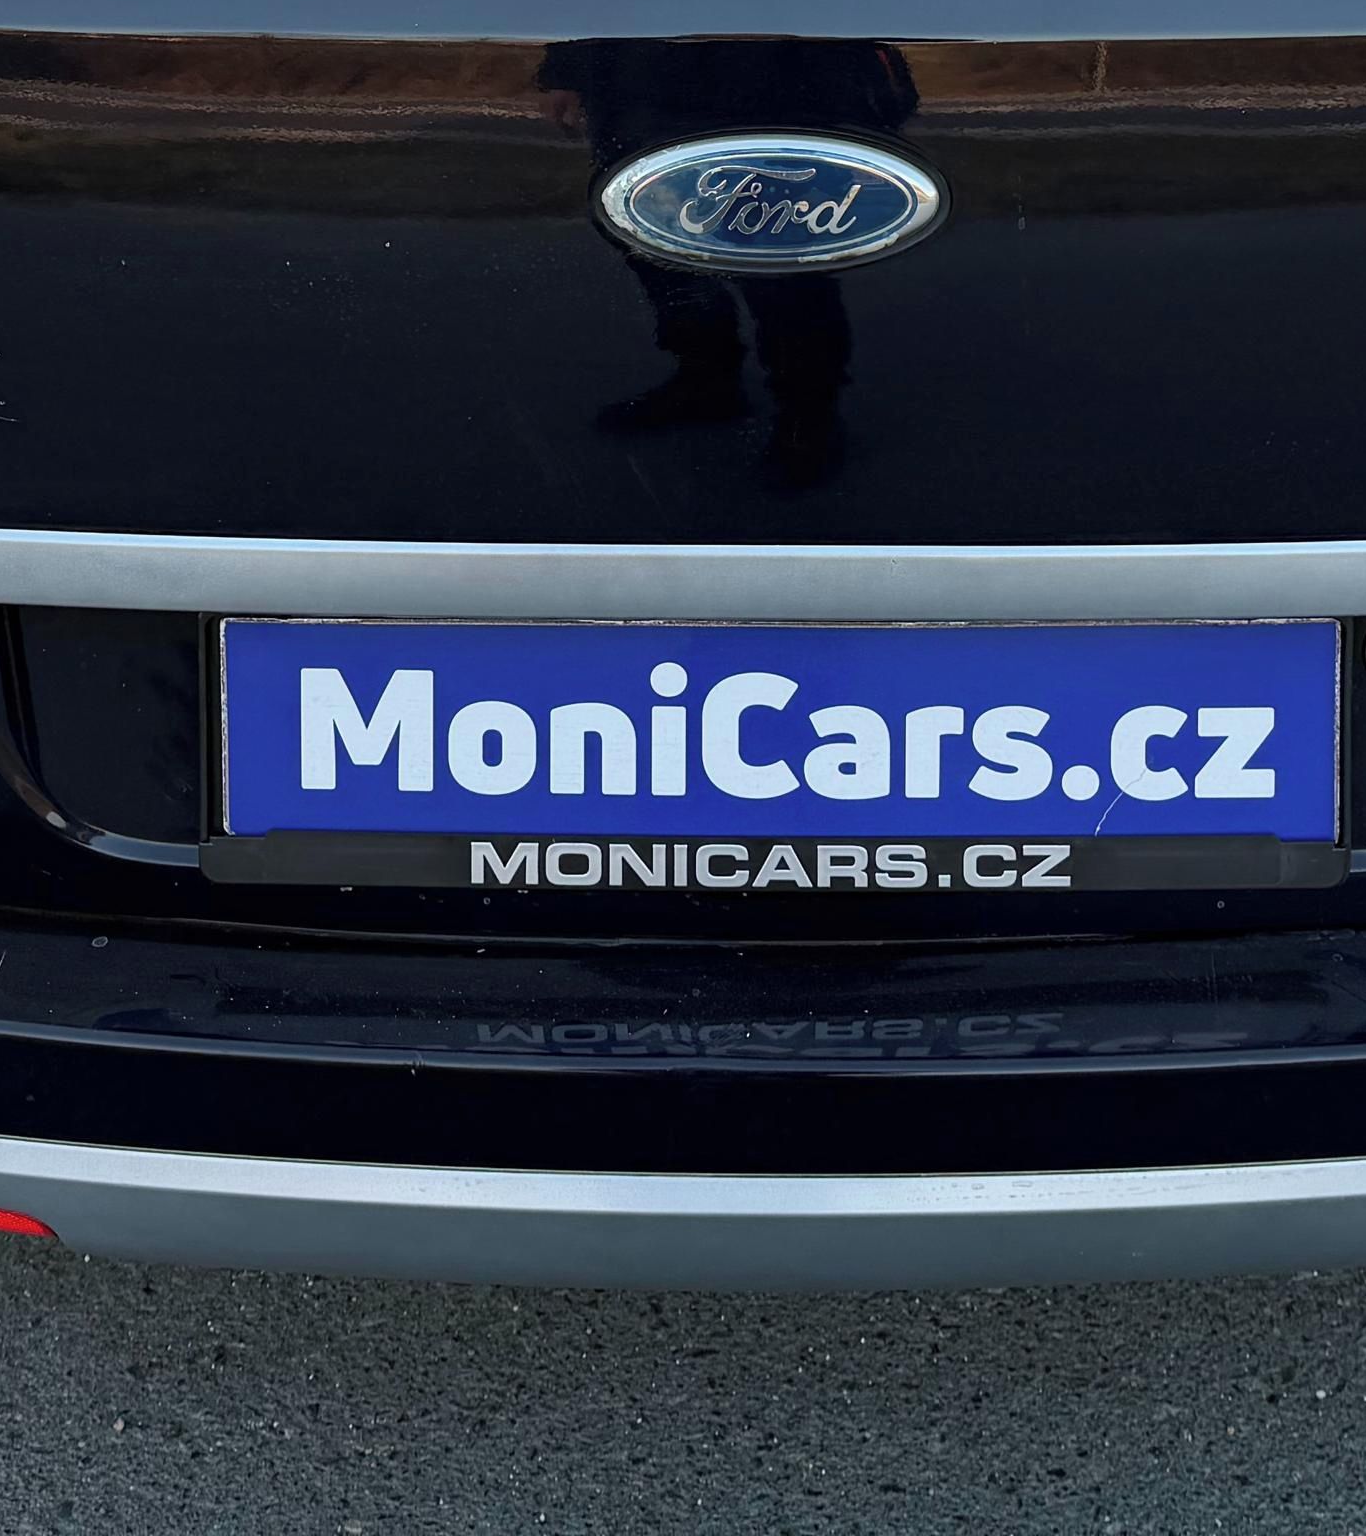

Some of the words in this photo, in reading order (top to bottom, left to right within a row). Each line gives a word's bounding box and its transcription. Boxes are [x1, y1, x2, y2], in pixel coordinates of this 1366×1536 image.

[680, 164, 862, 235] Ford
[298, 661, 1277, 801] MoniCars.cz
[469, 841, 1072, 888] MONICARS.CZ
